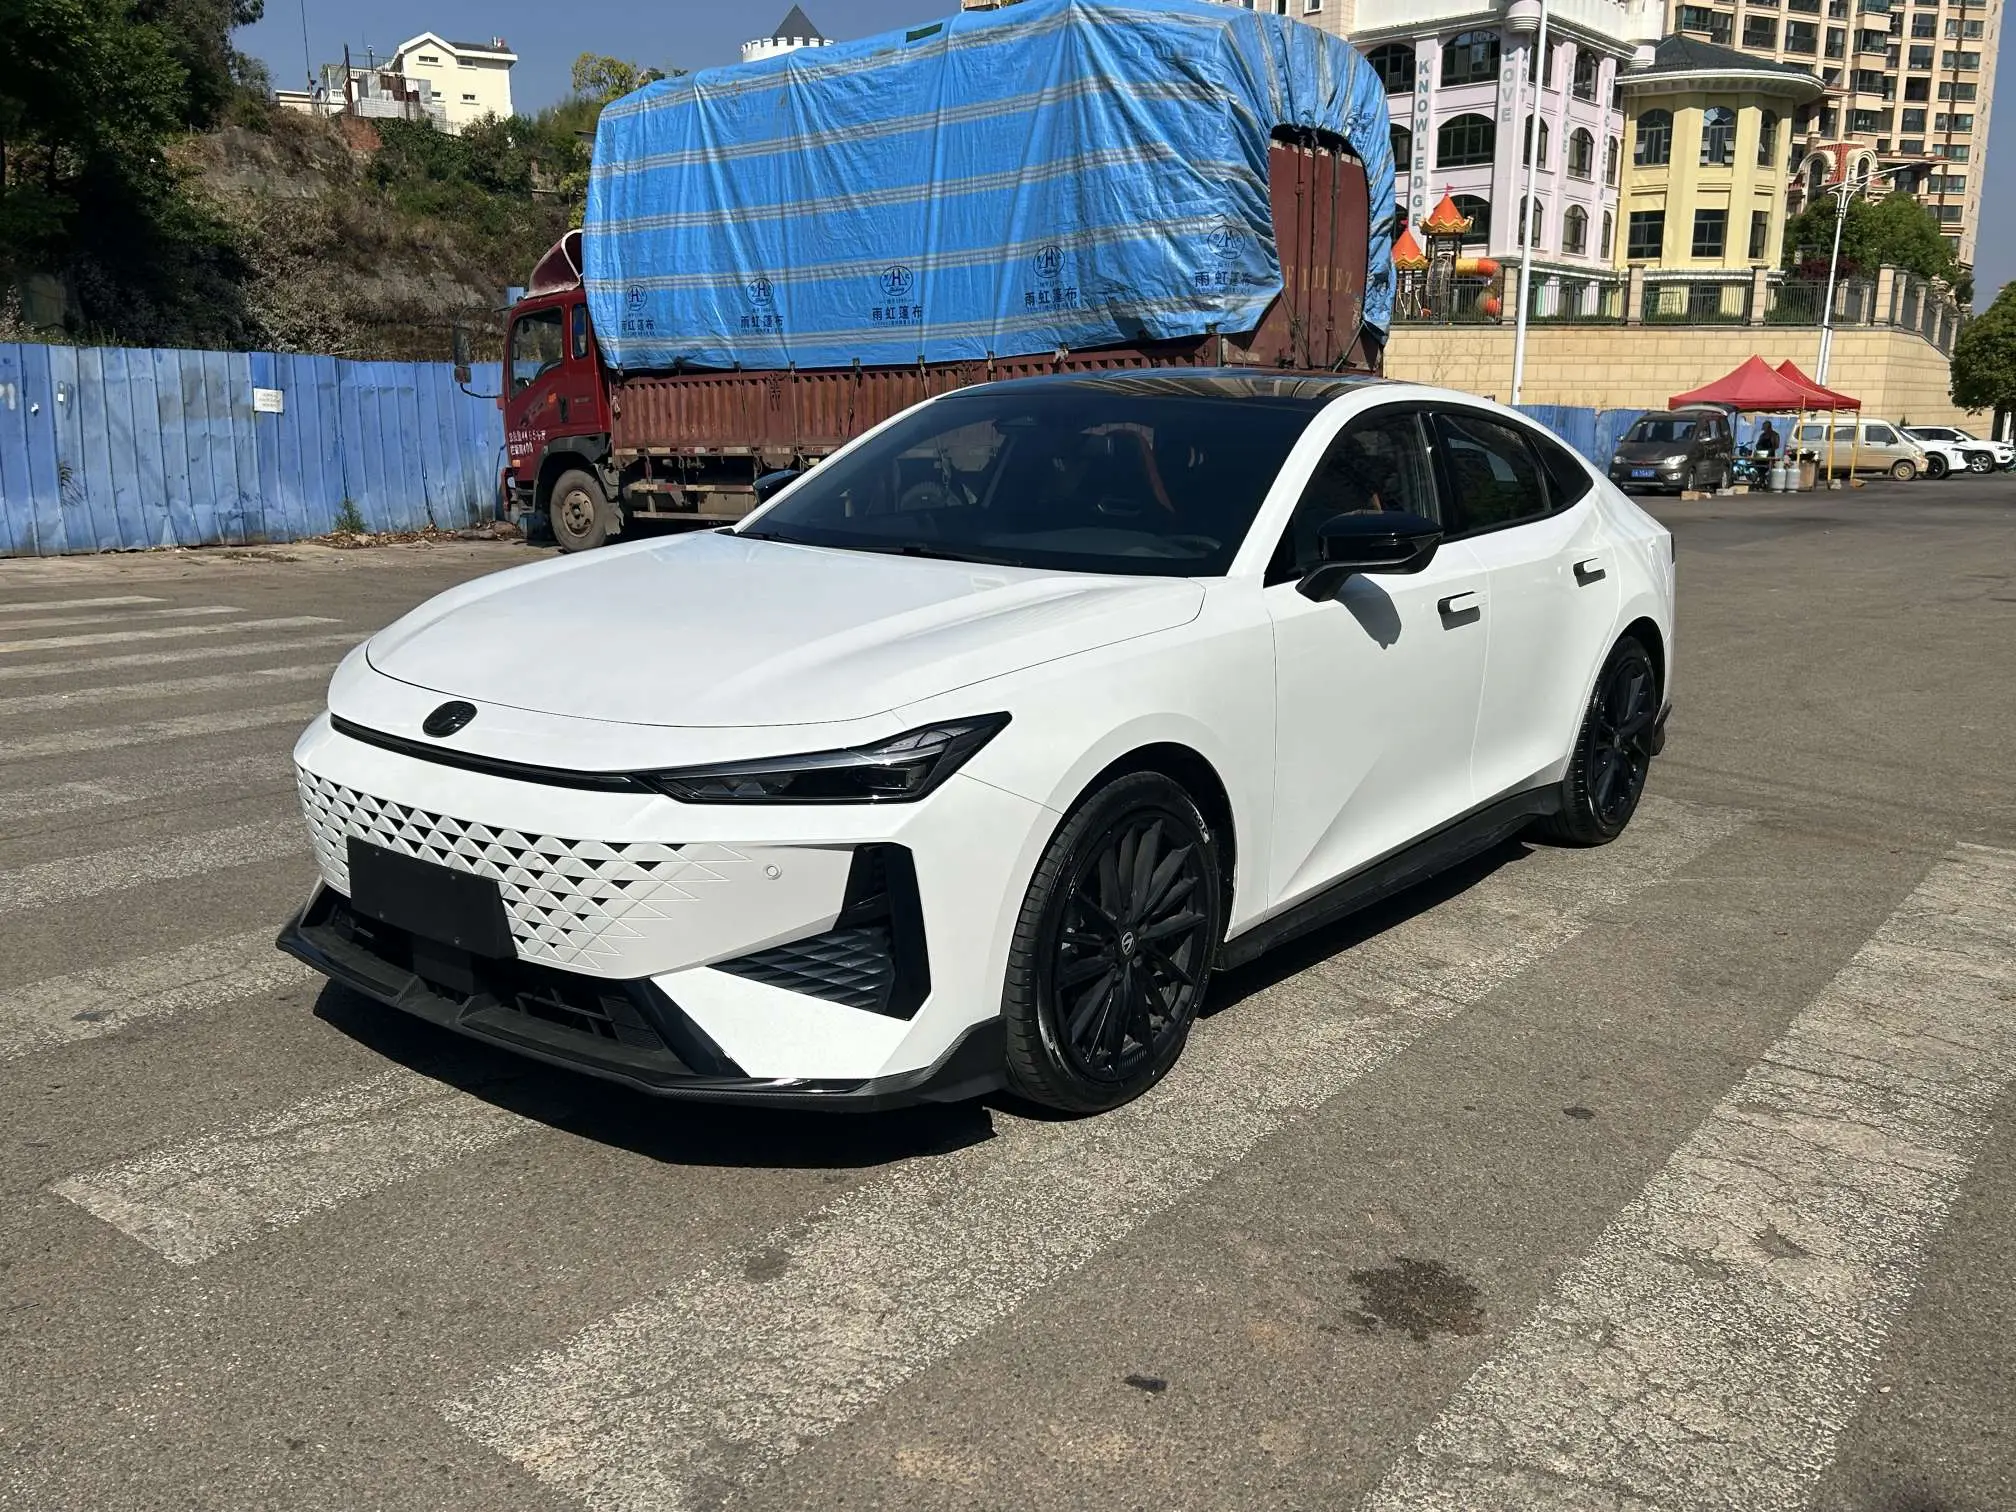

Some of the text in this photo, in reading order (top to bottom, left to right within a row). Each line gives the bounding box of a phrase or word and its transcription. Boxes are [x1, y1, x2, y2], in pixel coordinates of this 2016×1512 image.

[1501, 48, 1514, 122] LOVE
[1520, 48, 1529, 103] ART
[1412, 59, 1430, 227] KNOWLEDGE
[1599, 78, 1613, 201] SUCCESS
